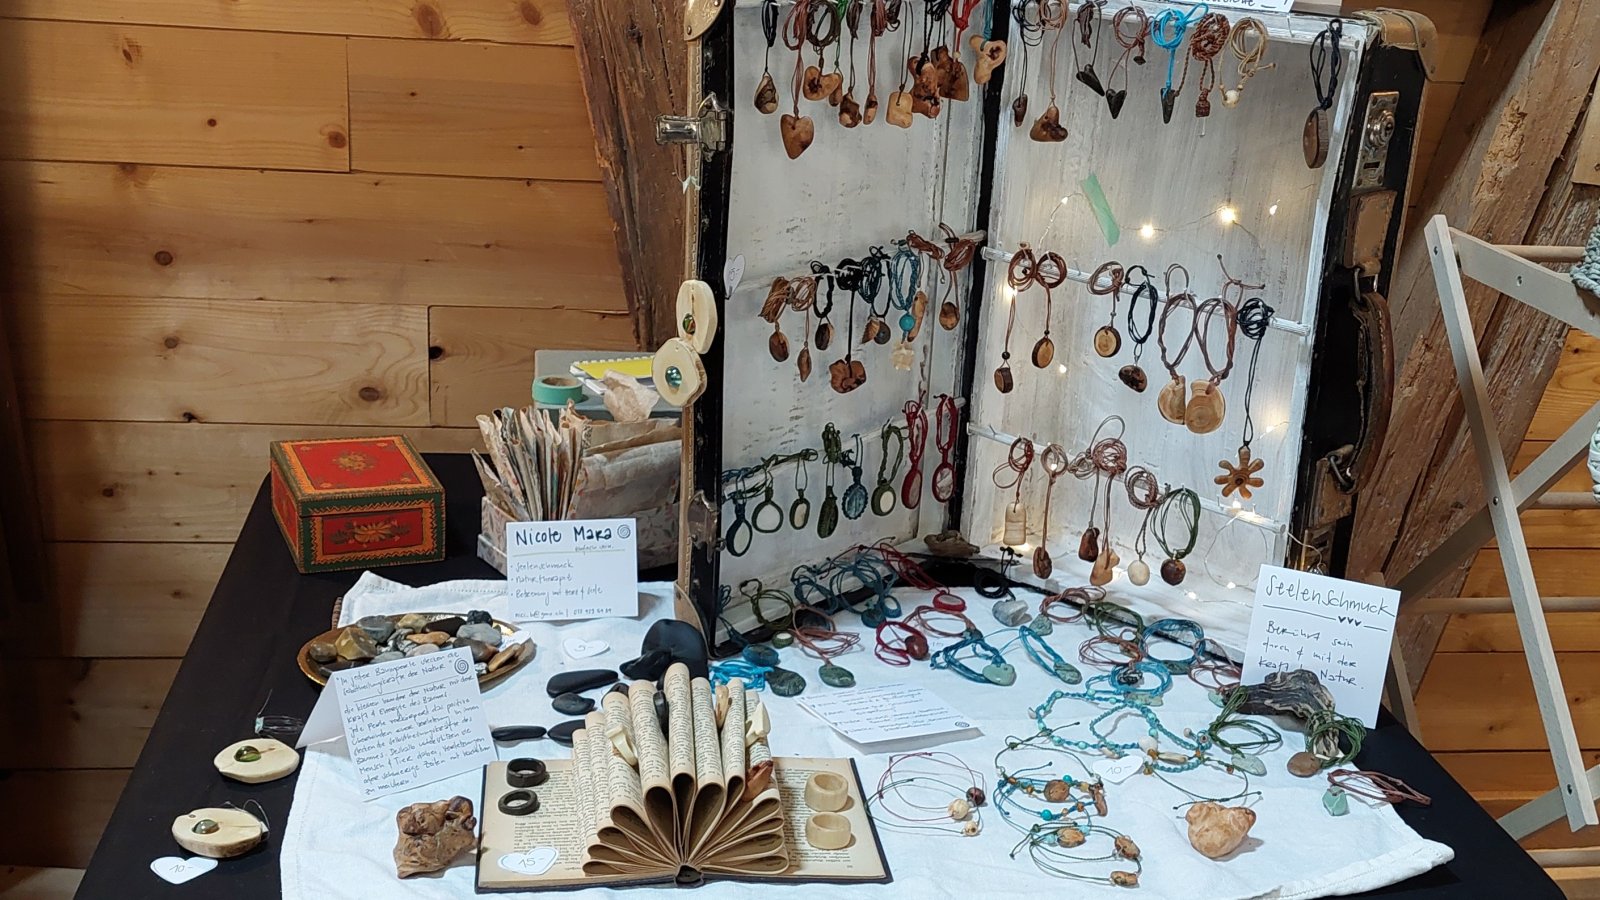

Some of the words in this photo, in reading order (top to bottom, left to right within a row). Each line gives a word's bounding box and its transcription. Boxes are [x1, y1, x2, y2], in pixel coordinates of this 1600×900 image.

[515, 527, 561, 546] Nicole
[1262, 637, 1290, 653] durch
[1313, 651, 1332, 664] mit
[1332, 638, 1354, 648] sein
